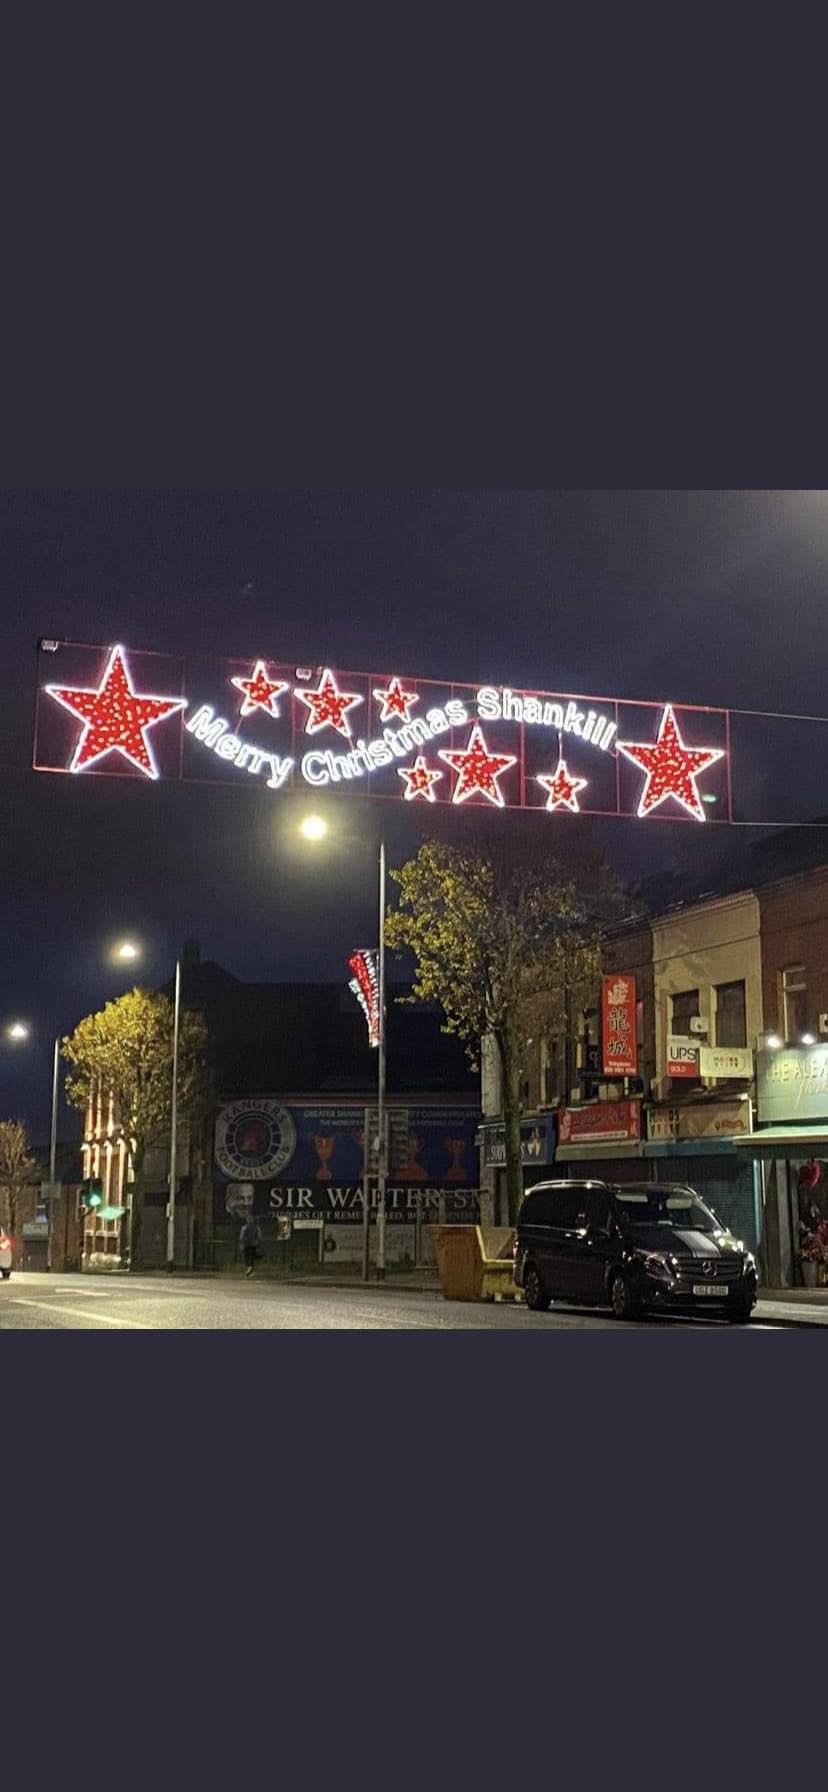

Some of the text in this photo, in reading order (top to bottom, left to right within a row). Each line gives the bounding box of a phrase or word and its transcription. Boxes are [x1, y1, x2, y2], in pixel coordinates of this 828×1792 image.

[186, 687, 618, 788] Merry Christmas Shankill
[670, 1046, 697, 1061] UPS
[670, 1065, 687, 1073] SOLD
[222, 1099, 289, 1122] RANGERS
[216, 1145, 290, 1178] FOOTBALL CLUB
[269, 1187, 315, 1208] SIR
[326, 1187, 441, 1208] WALTER
